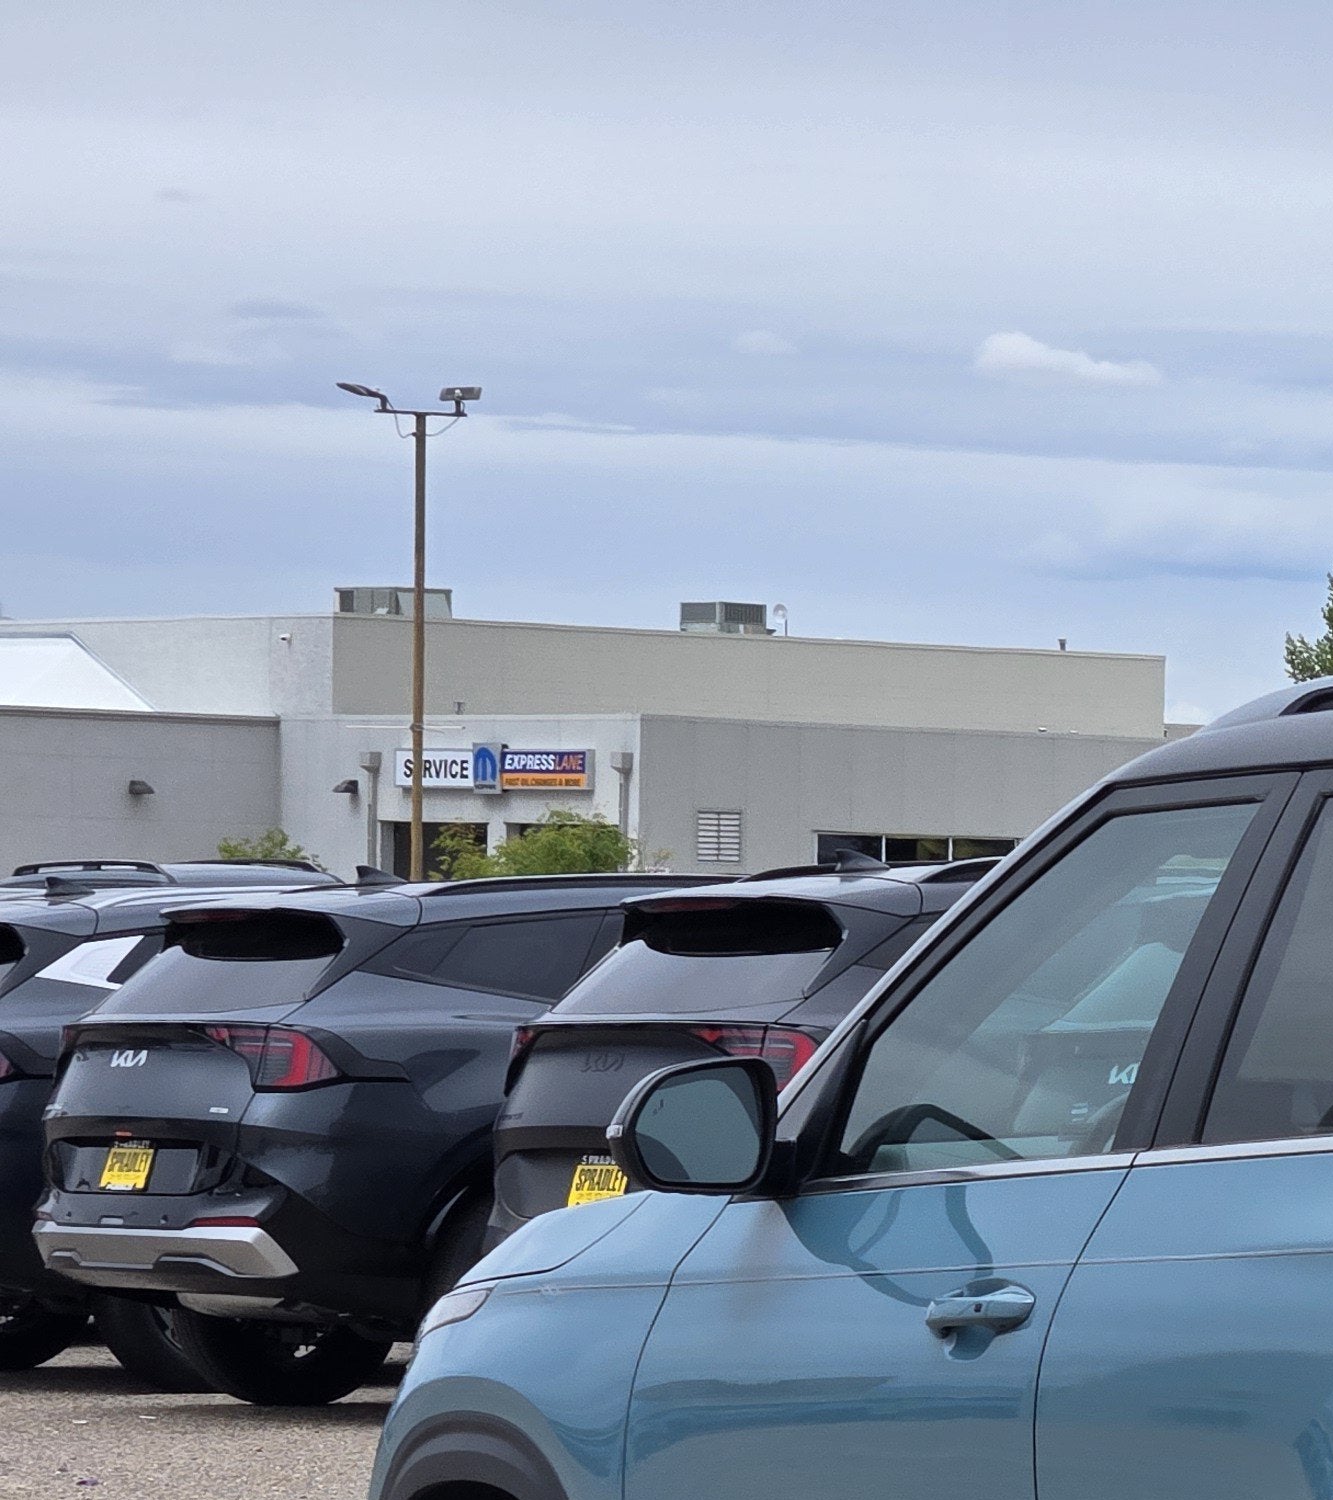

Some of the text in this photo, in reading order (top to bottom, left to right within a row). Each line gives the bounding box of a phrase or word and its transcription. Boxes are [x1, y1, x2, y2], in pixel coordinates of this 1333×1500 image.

[403, 758, 469, 780] SRVICE
[110, 1050, 148, 1068] KIA
[1108, 1062, 1140, 1084] KI
